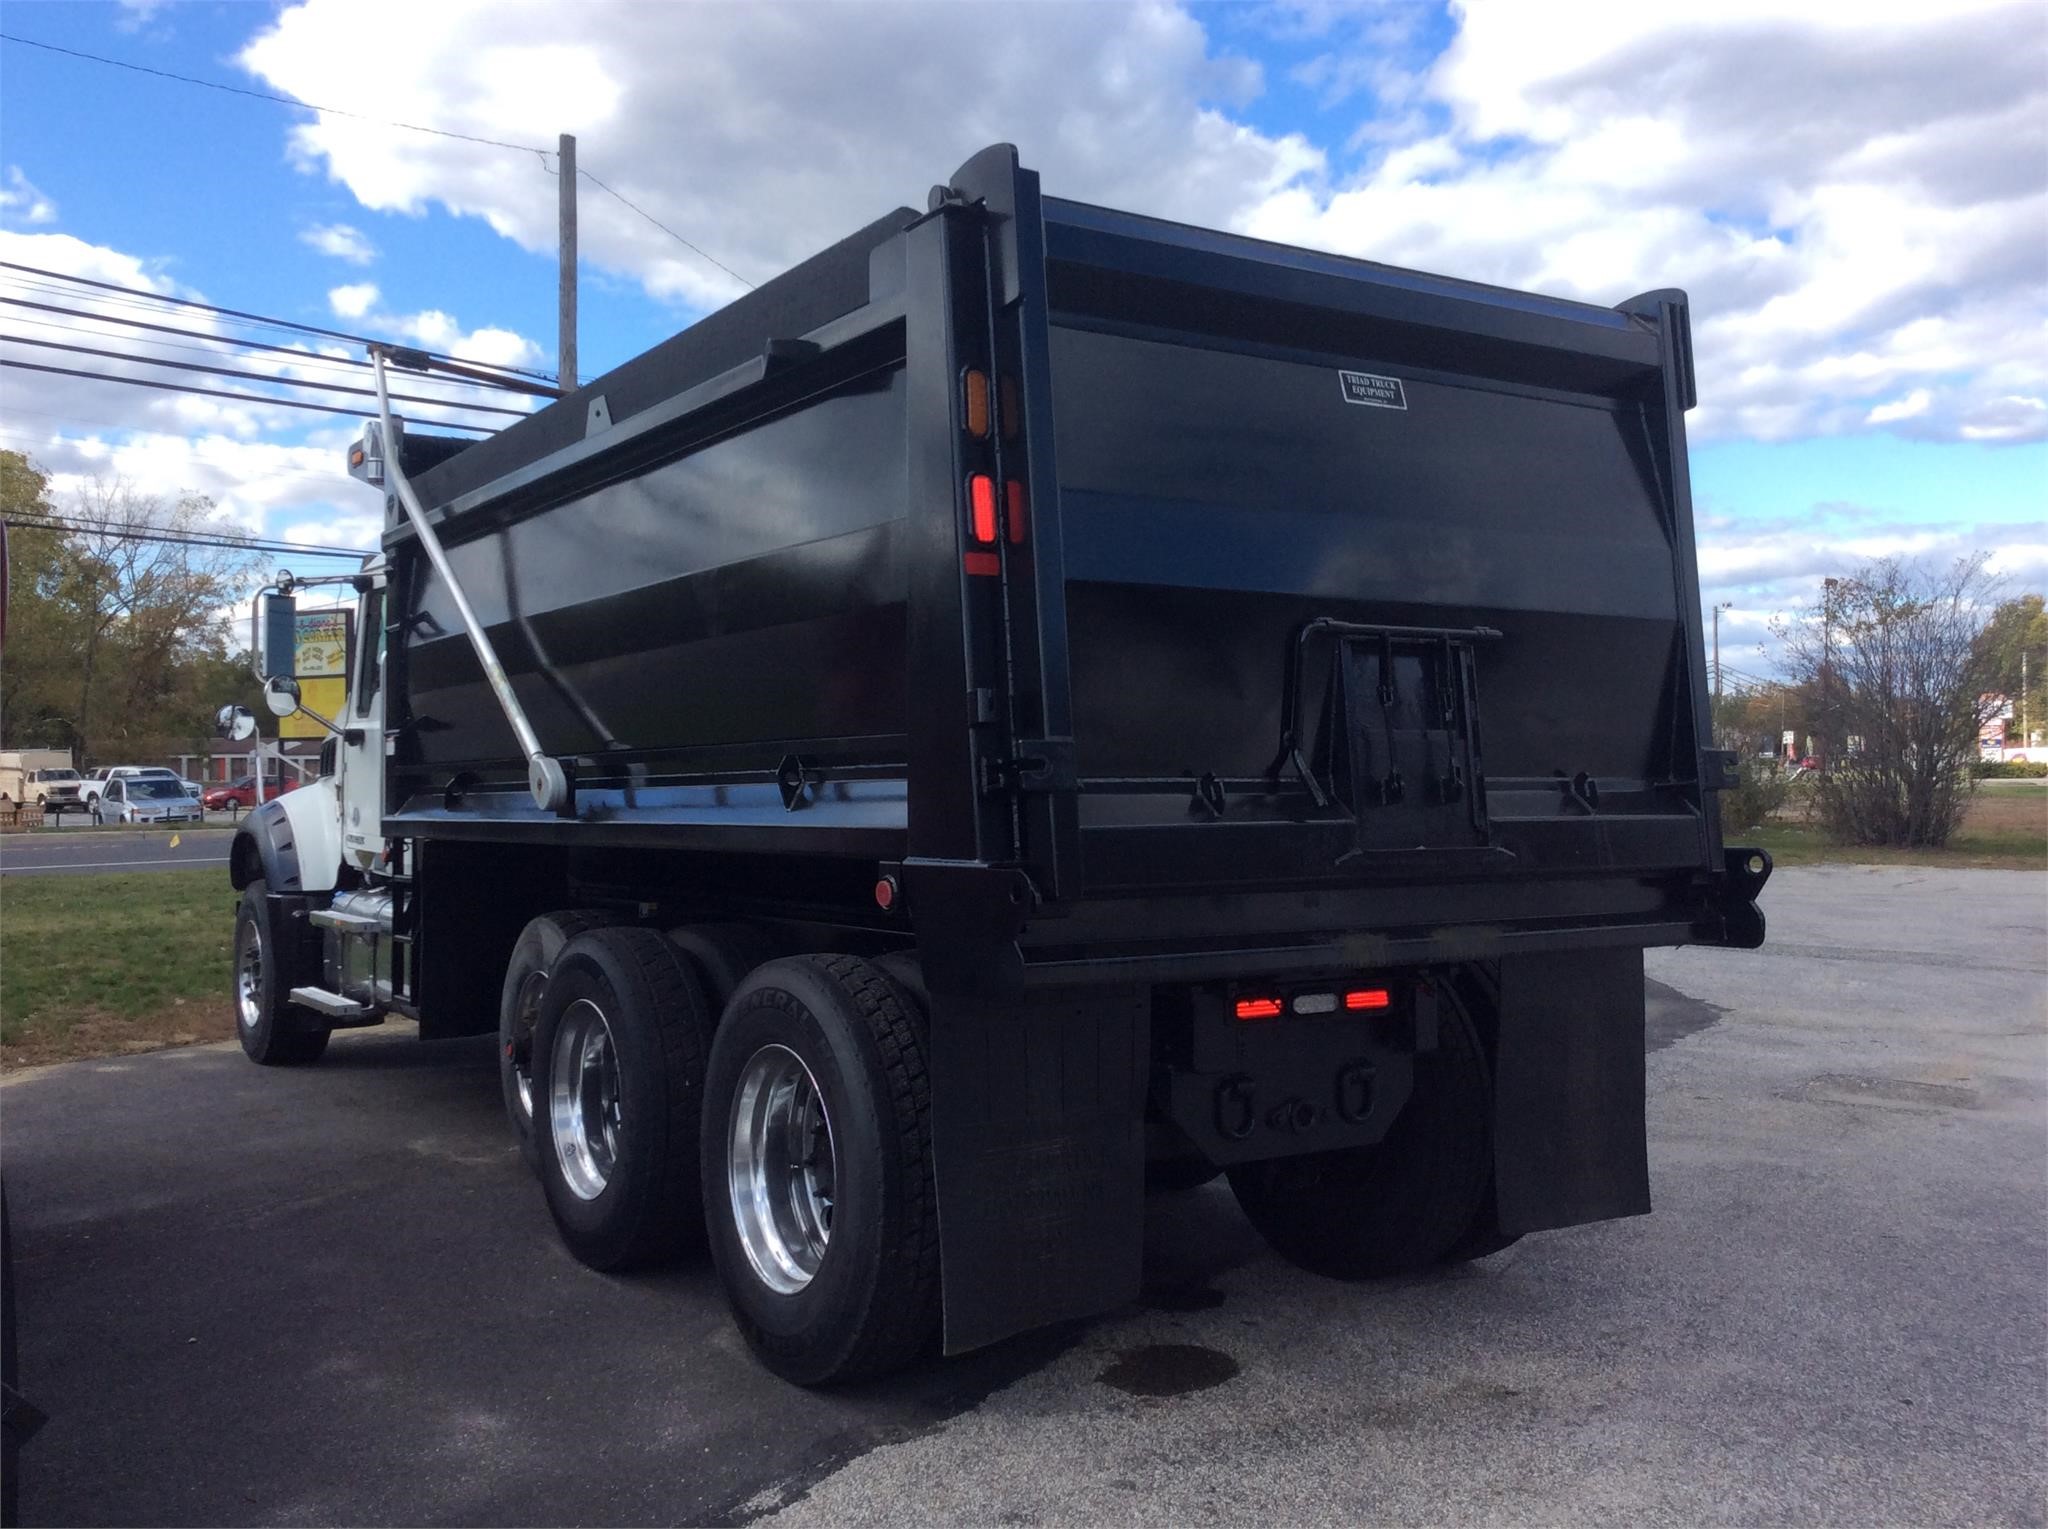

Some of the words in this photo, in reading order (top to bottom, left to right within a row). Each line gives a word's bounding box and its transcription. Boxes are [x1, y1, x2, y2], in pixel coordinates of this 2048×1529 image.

[1346, 374, 1370, 386] TRIAD
[1371, 378, 1396, 390] TRUCK
[1352, 385, 1395, 399] EQUIPMENT
